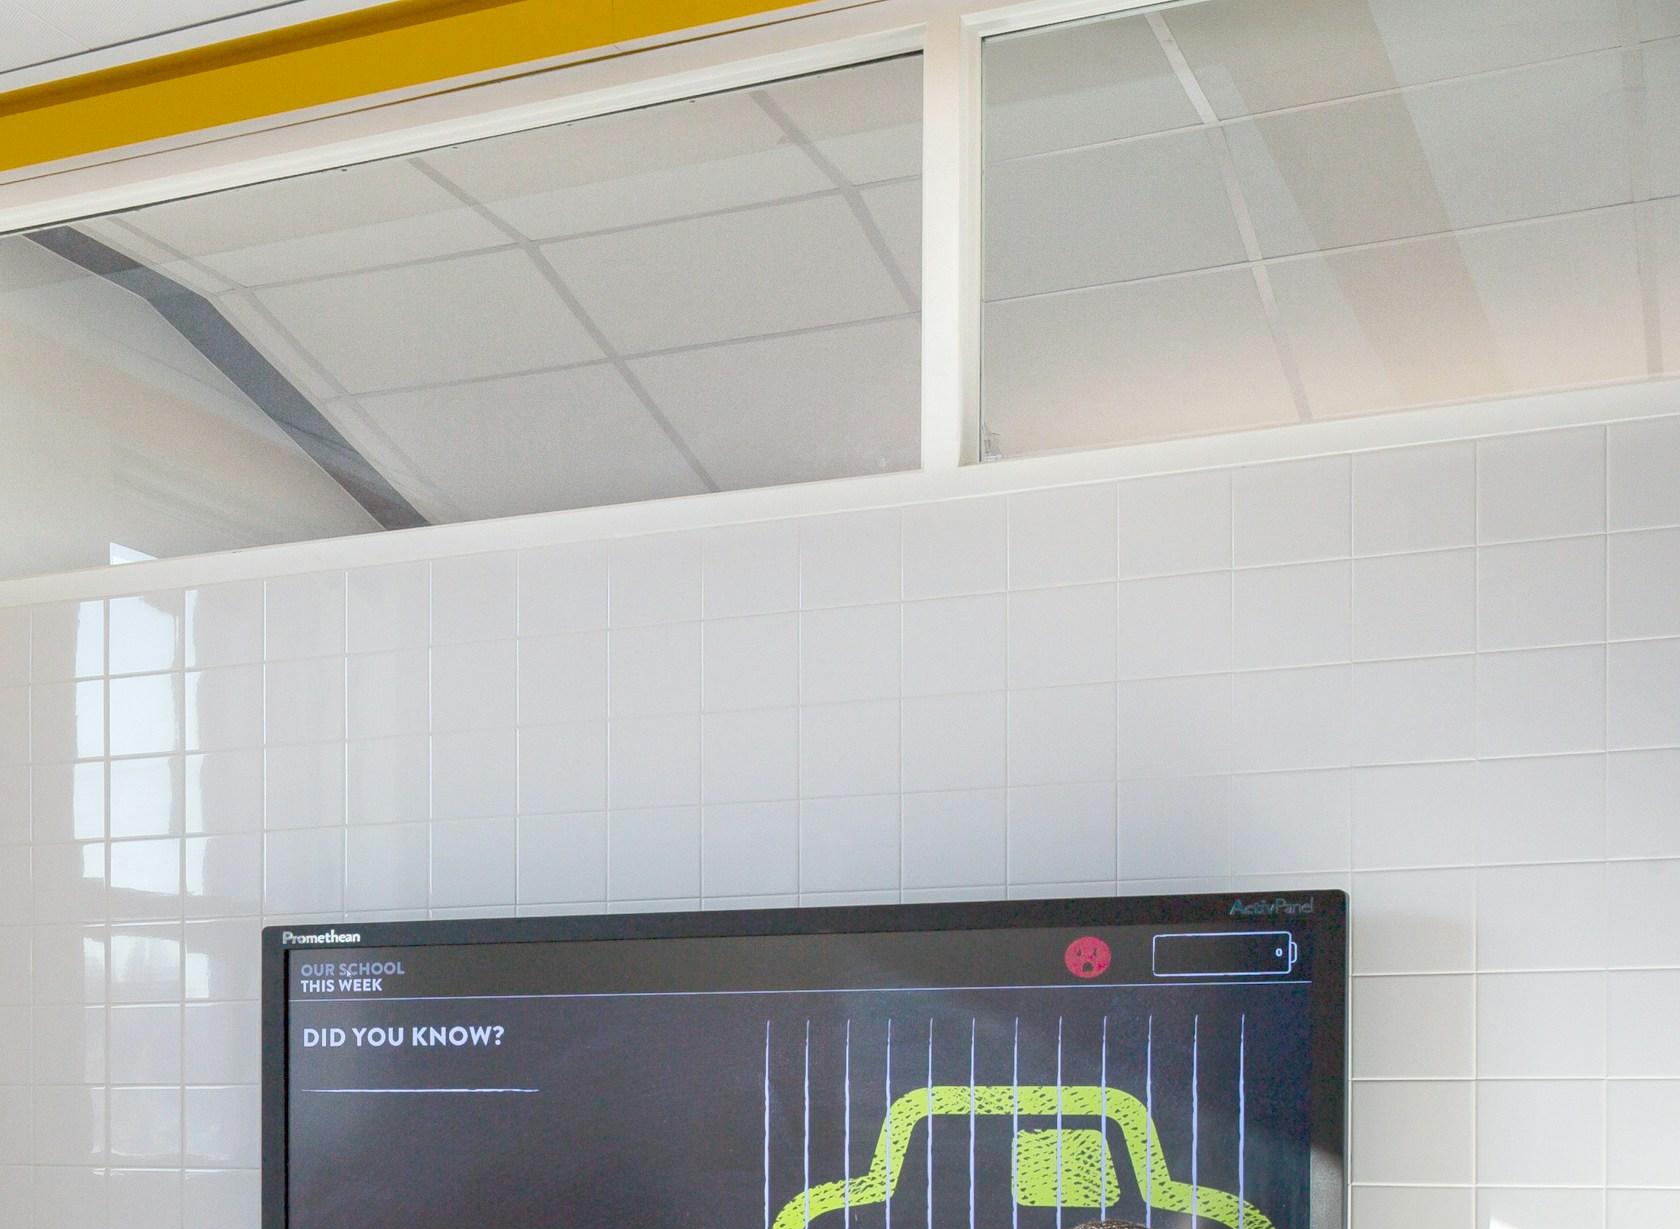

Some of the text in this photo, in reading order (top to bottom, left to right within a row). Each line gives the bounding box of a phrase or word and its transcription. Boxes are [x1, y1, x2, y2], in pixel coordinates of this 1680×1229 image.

[1229, 897, 1314, 915] ActivPanel
[282, 929, 361, 945] Promethean
[1275, 947, 1283, 957] 0
[300, 961, 405, 977] OUR SCHOOL
[300, 978, 383, 993] THIS WEEK
[303, 1026, 505, 1047] DID YOU KNOW?
